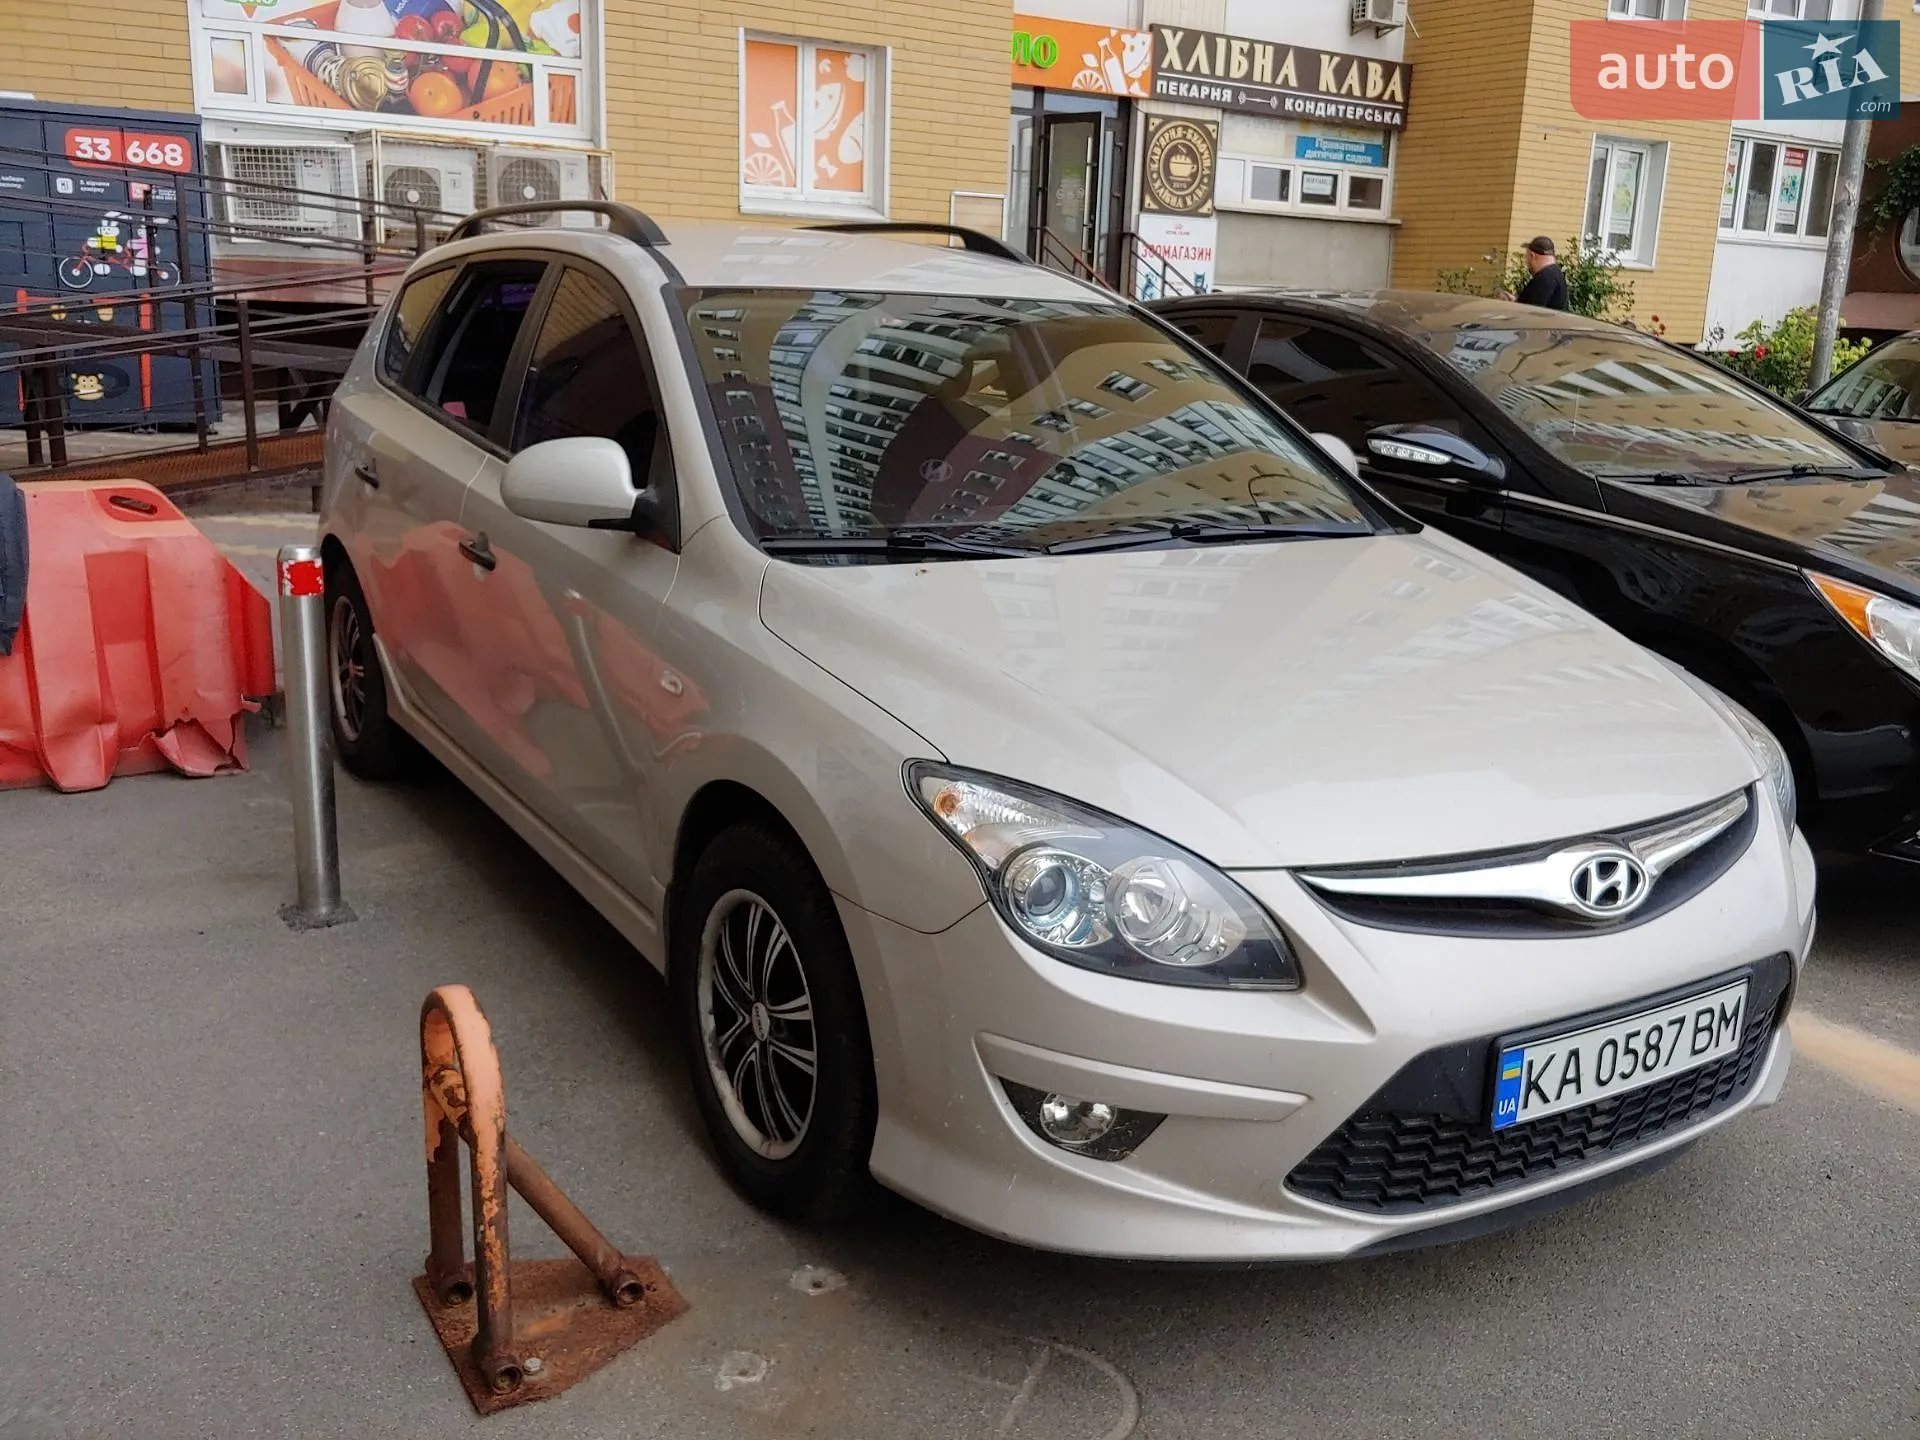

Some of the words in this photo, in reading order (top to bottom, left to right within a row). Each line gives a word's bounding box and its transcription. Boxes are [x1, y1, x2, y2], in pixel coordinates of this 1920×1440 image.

[1160, 28, 1299, 88] ХЛІБНА
[1318, 53, 1404, 103] КАВА
[1156, 79, 1232, 103] ПЕКАРНЯ
[1284, 97, 1402, 125] КОНДИТЕРСЬКА
[74, 135, 112, 161] 33
[126, 140, 184, 167] 668
[1141, 243, 1212, 262] ЗООМАГАЗИН
[1522, 1047, 1582, 1110] KA
[1595, 1015, 1686, 1087] 0587
[1690, 994, 1741, 1057] BM
[1497, 1098, 1517, 1117] UA
